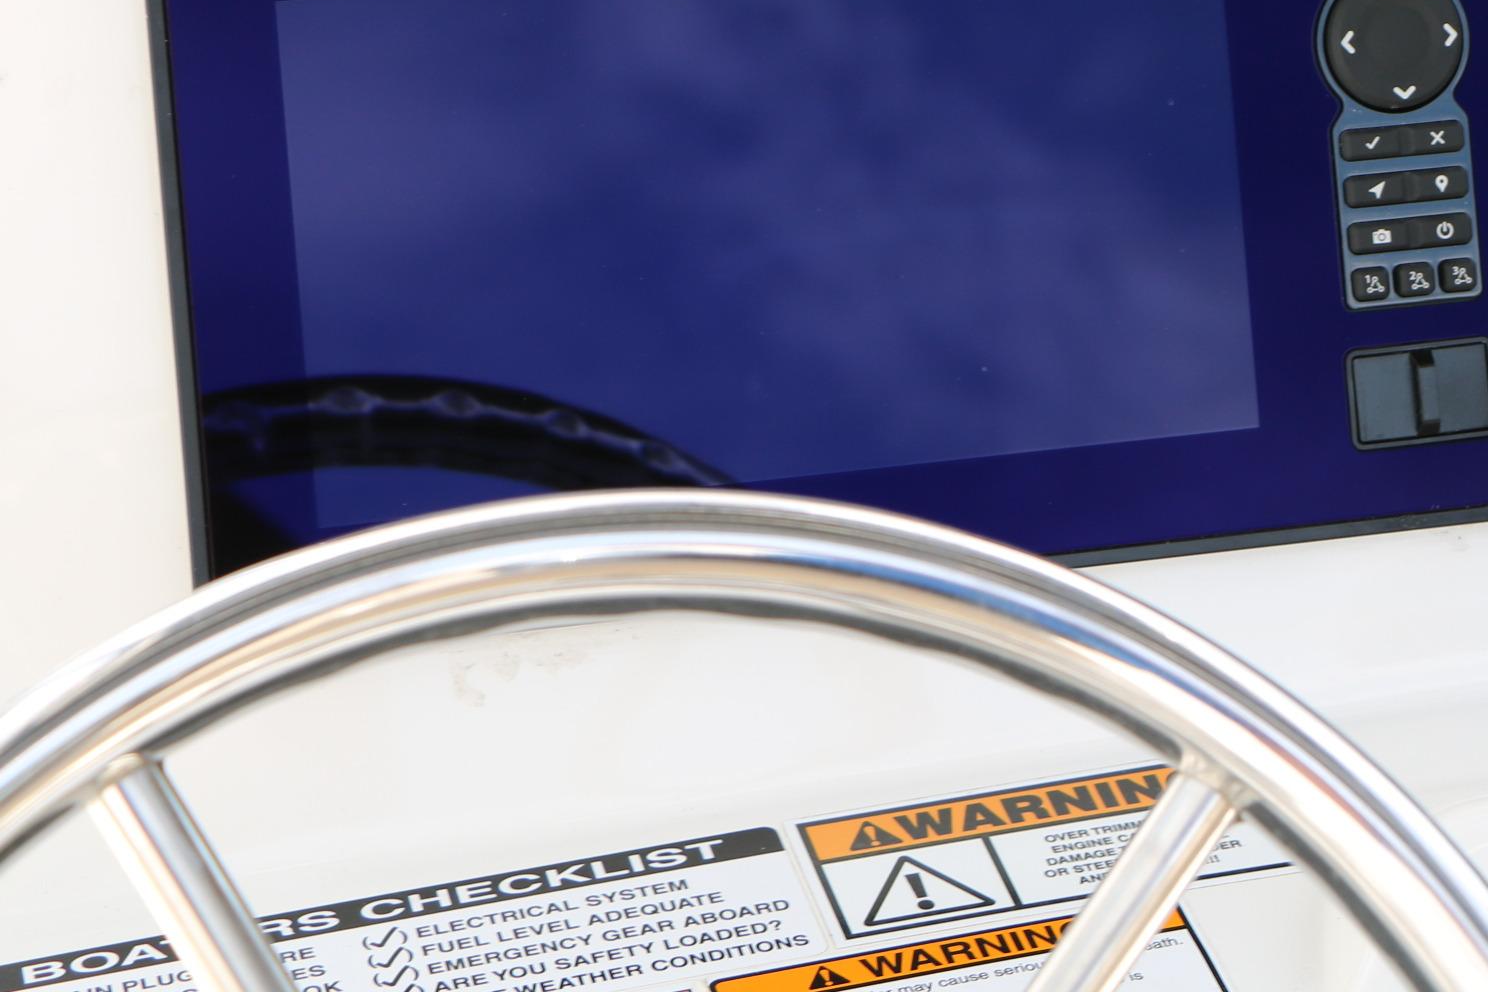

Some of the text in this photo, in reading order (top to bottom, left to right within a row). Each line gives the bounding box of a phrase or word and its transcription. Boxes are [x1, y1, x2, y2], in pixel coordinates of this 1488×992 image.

[894, 771, 1176, 841] WARNIN
[1044, 829, 1089, 844] OVER
[1046, 848, 1118, 866] DAMAGE
[1051, 837, 1113, 854] ENGINE
[359, 839, 724, 920] CHECKLIST
[1044, 868, 1070, 878] OR
[416, 879, 689, 939] ELECTRICAL SYSTEM
[422, 891, 725, 957] FUEL LEVEL ADEQUATE
[427, 899, 790, 975] EMERGENCY GEAR ABOARD
[434, 920, 783, 992] ARE YOU SAFETY LOADED?
[514, 934, 810, 992] WEATHER CONDITIONS
[860, 919, 1073, 977] WARNIN
[938, 968, 990, 987] cause
